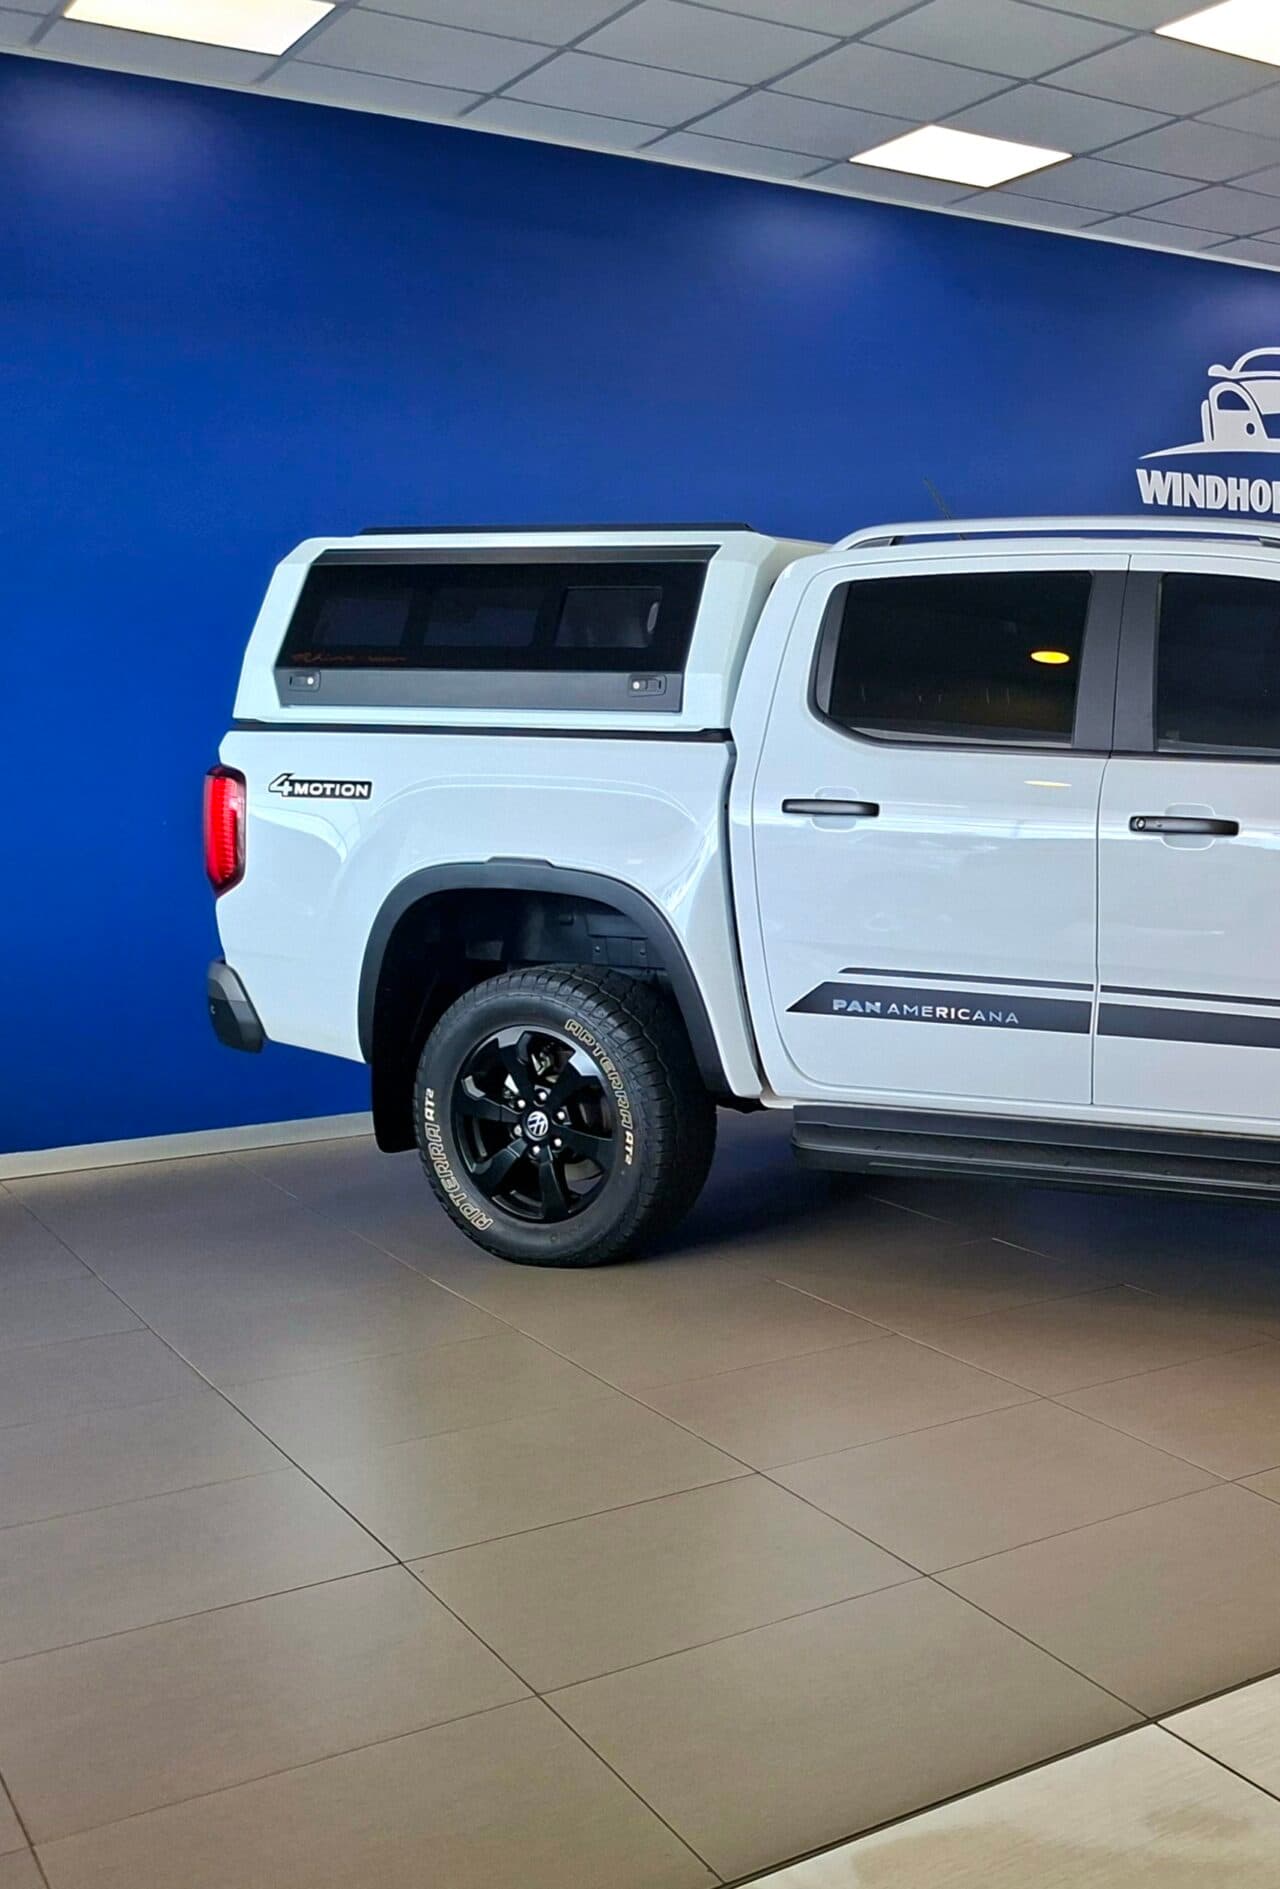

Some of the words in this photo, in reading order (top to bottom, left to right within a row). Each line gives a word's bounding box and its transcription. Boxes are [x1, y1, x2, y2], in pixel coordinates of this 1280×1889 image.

[268, 773, 371, 798] 4MOTION
[832, 999, 882, 1014] PAN
[887, 1003, 1019, 1024] AMERICANA
